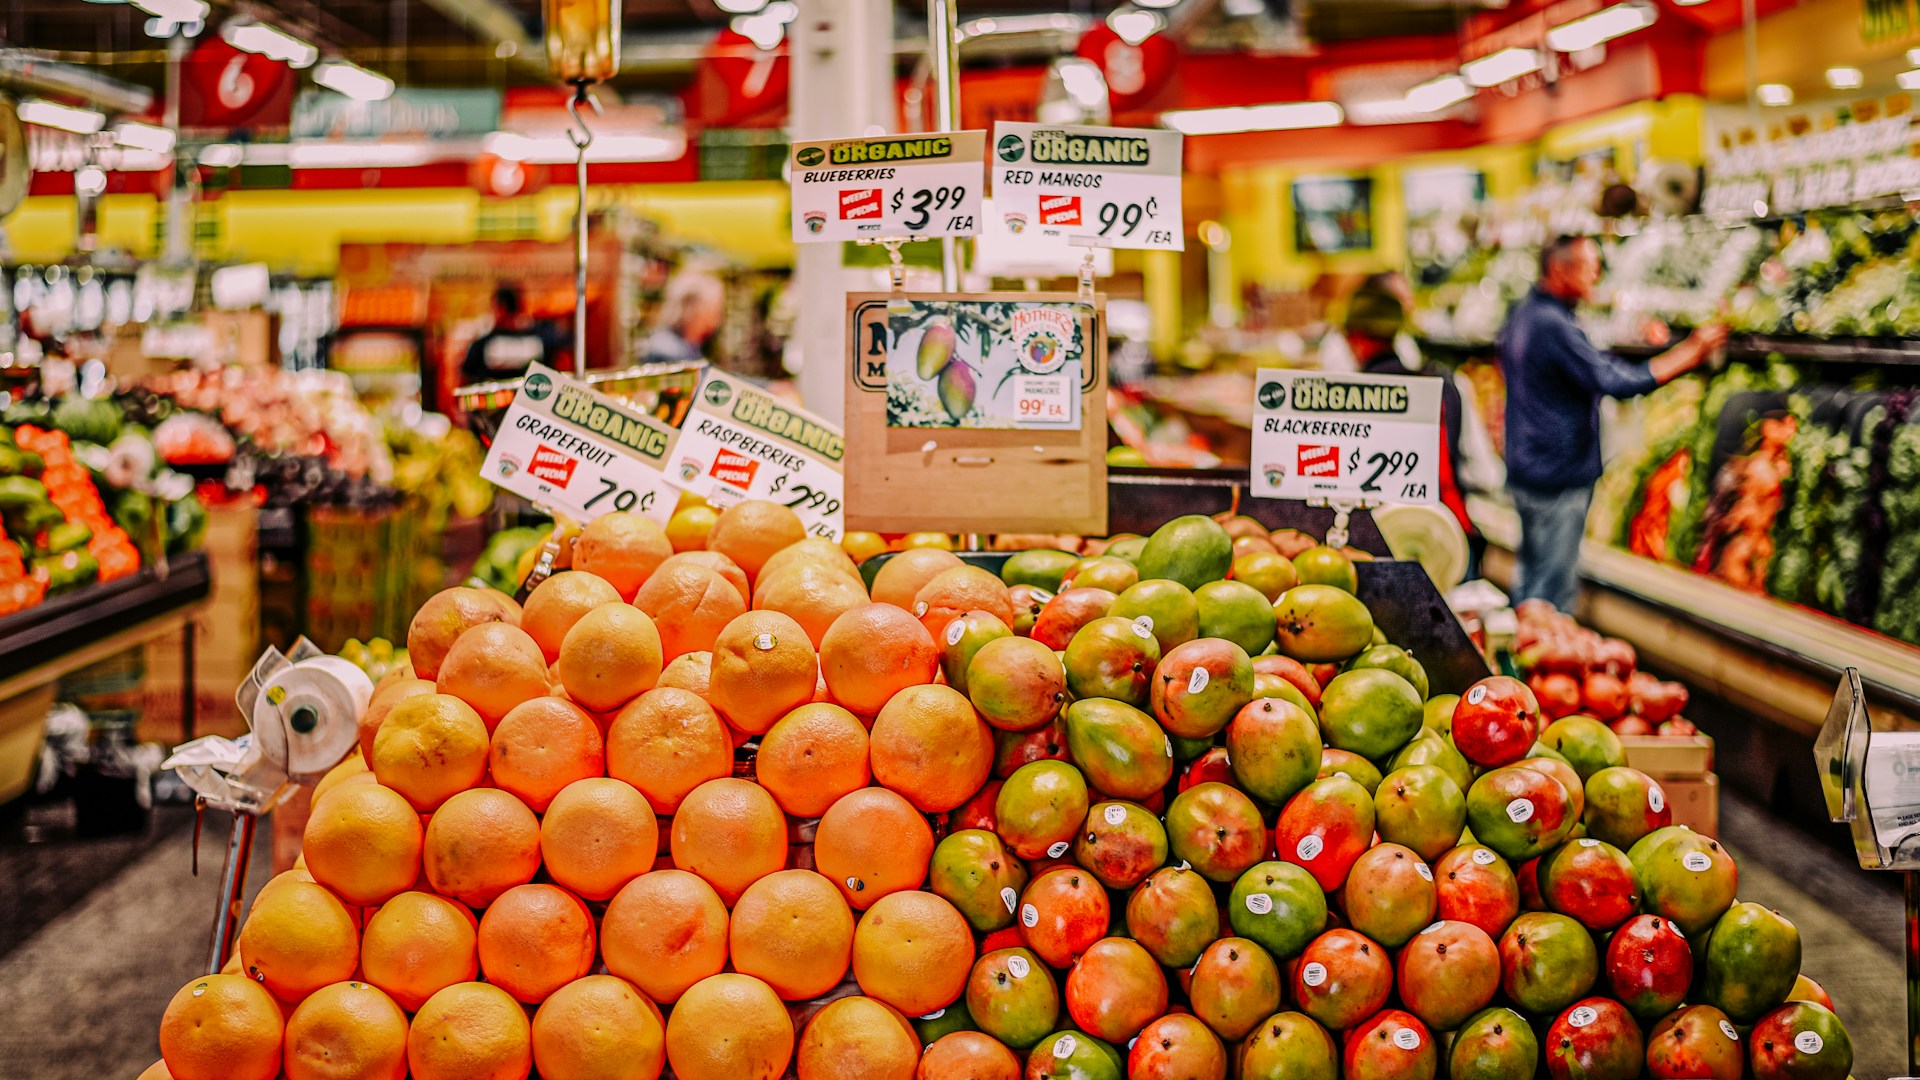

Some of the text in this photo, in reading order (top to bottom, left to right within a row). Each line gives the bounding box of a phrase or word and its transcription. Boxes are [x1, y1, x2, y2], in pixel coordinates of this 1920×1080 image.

[218, 53, 255, 109] 6
[833, 137, 950, 164] ORGANIC
[1033, 137, 1149, 163] ORGANIC
[804, 168, 896, 183] BLUEBERRIES
[1004, 170, 1102, 188] RED MANGOS
[946, 216, 974, 231] /EA
[1145, 229, 1173, 244] /EA
[1294, 385, 1408, 411] ORGANIC
[555, 394, 668, 458] ORGANIC
[734, 397, 845, 461] ORGANIC
[1263, 418, 1372, 438] BLACKBERRIES
[516, 414, 618, 468] GRAPEFRUIT
[697, 419, 806, 473] RASPBERRIES
[1401, 483, 1428, 499] /EA
